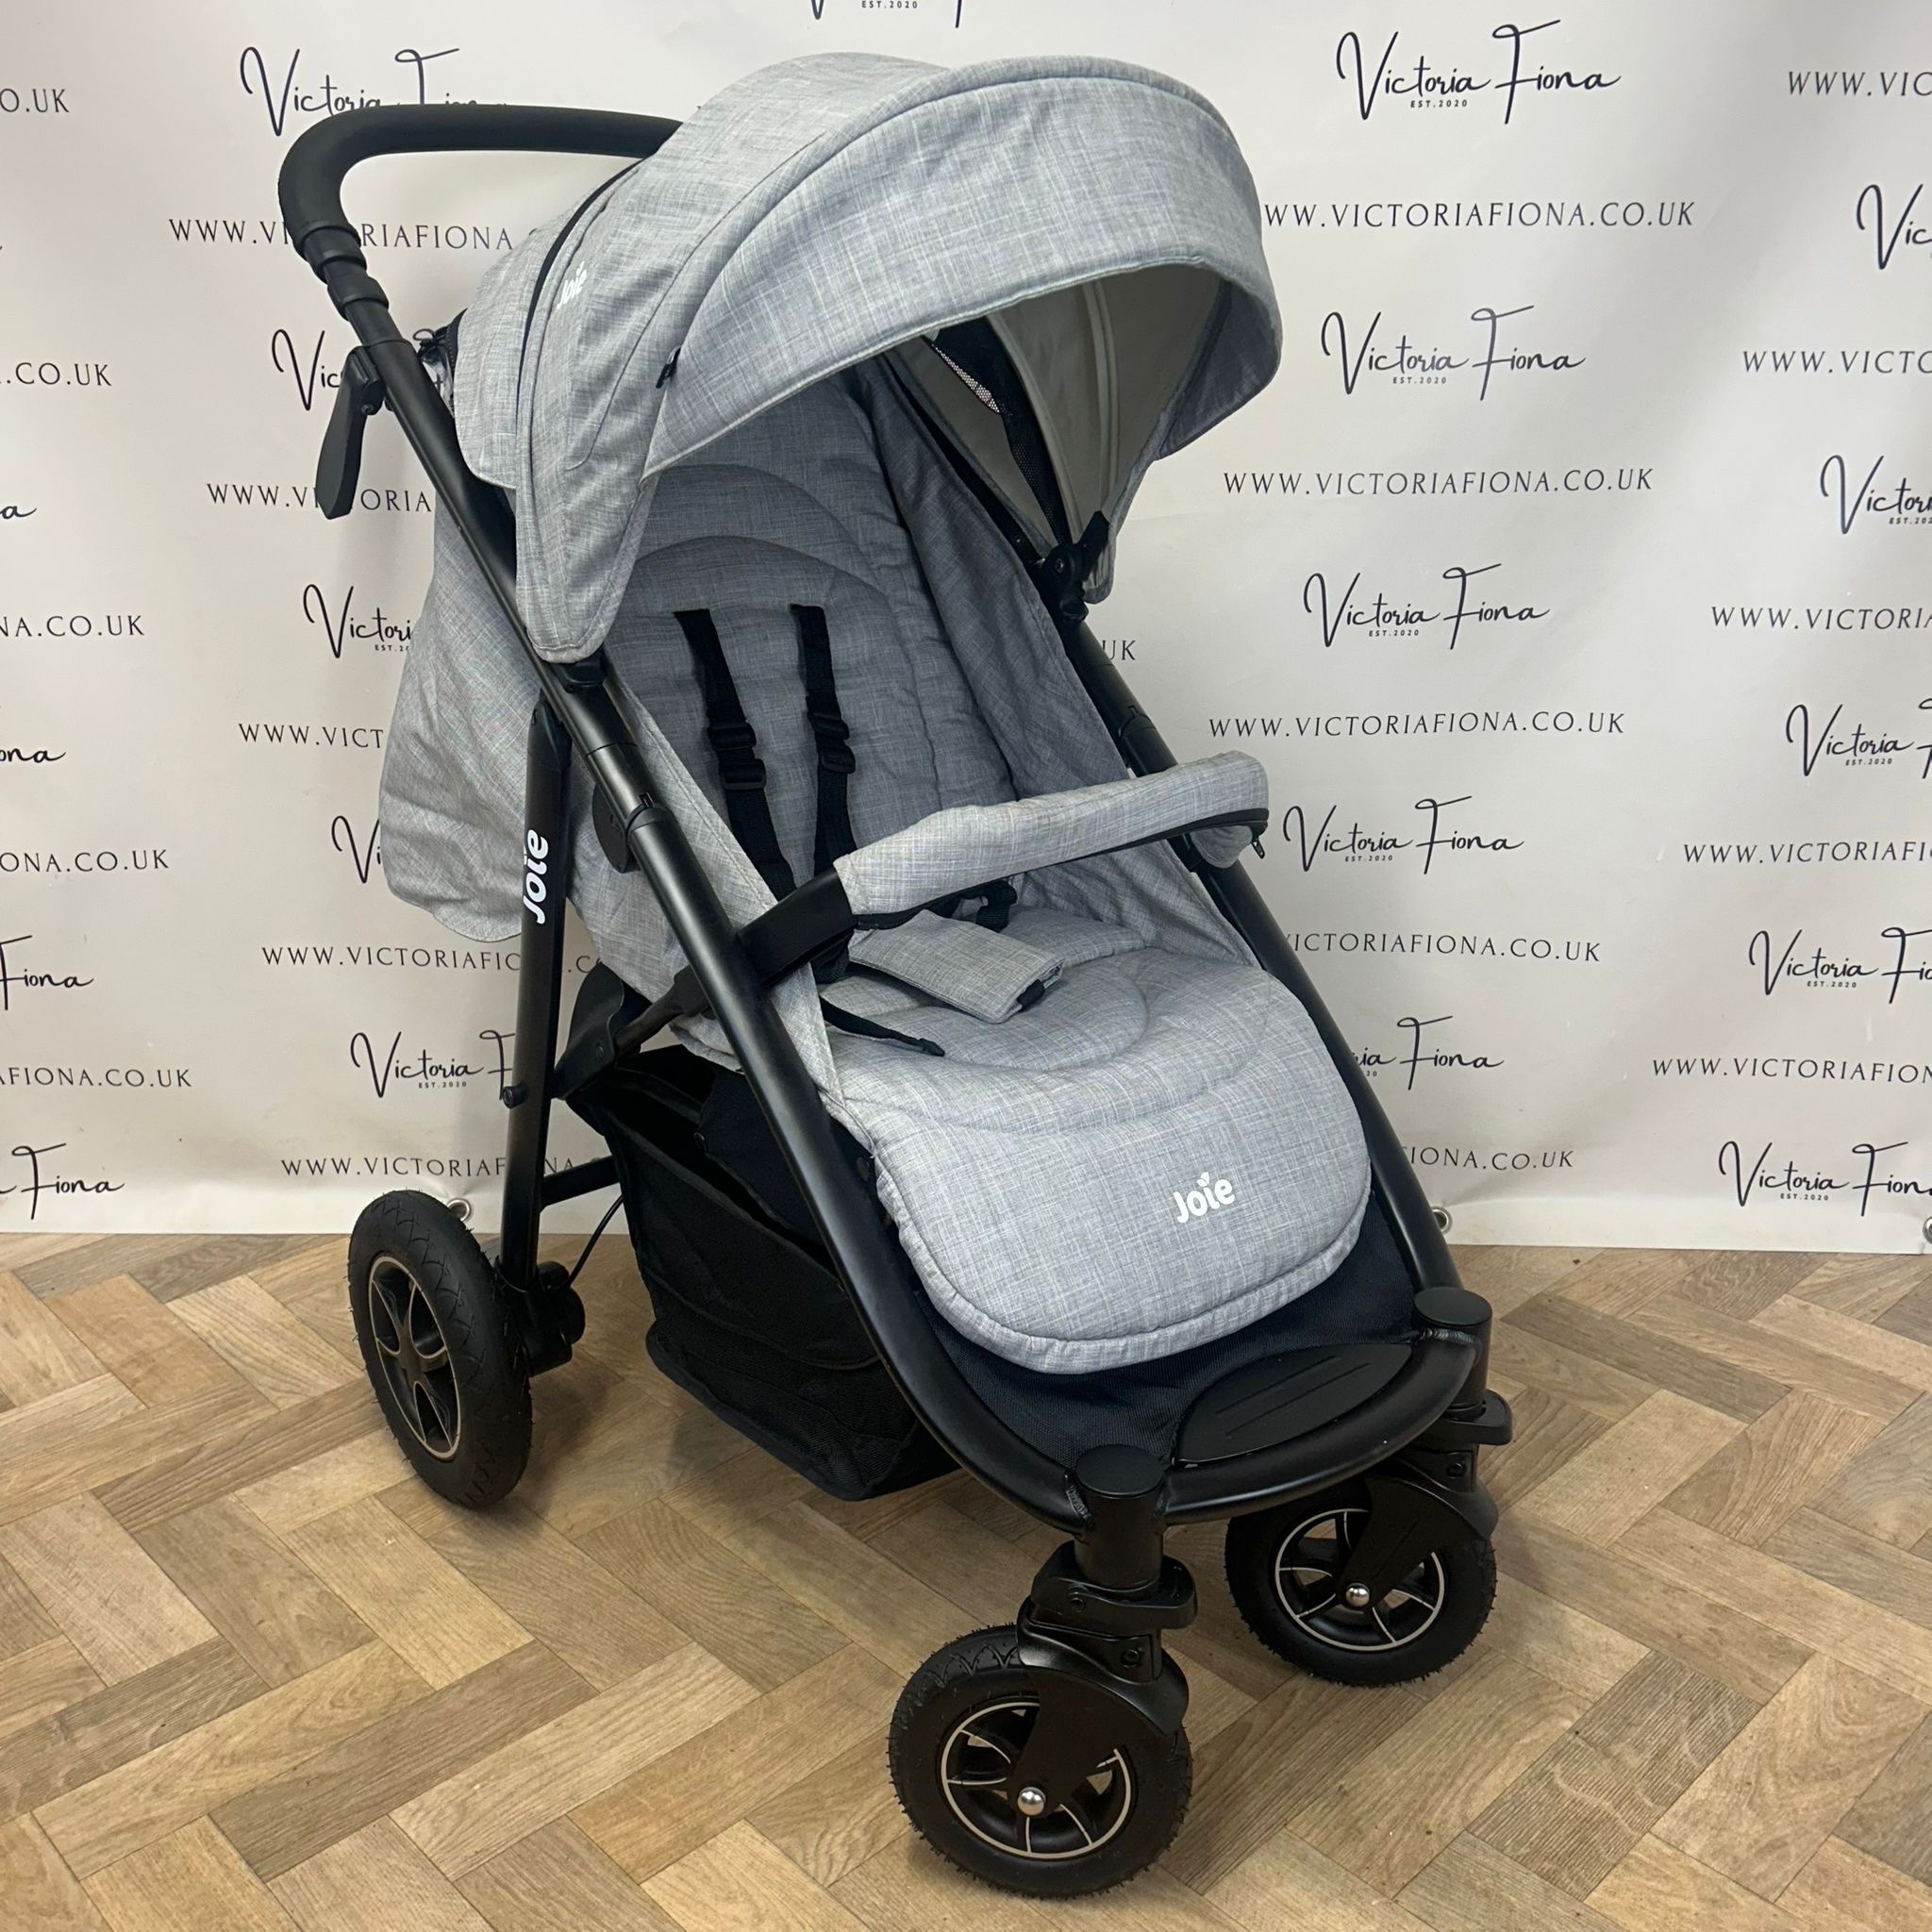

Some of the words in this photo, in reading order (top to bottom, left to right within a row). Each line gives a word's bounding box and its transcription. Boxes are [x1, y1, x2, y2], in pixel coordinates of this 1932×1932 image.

[1336, 30, 1491, 121] Victoria
[1491, 20, 1622, 125] Fiona
[1409, 99, 1468, 108] EST.2020
[1264, 202, 1695, 227] WW.VICTORIAFIONA.CO.UK
[1321, 311, 1470, 395] Victoria
[1471, 305, 1587, 401] Fiona
[1392, 376, 1447, 385] EST.2020
[1224, 468, 1654, 495] WWW.VICTORIAFIONA.CO.UK
[1303, 573, 1441, 647] Victoria
[1442, 563, 1551, 650] Fiona
[1368, 628, 1420, 637] EST.2020
[1208, 710, 1625, 739] WWW.VICTORIAFIONA.CO.UK
[1786, 704, 1915, 776] Victoria
[1283, 805, 1415, 873] Victoria
[1415, 795, 1524, 874] Fiona
[1683, 841, 1932, 864] WWW.VICTORIAFI
[1749, 929, 1879, 996] Victoria
[1807, 980, 1857, 989] EST.2020
[350, 1031, 485, 1098] Victoria
[1396, 1015, 1505, 1091] Fiona
[11, 1142, 125, 1220] Fiona
[1173, 1172, 1236, 1224] Joie
[1719, 1141, 1850, 1207] Victoria
[1852, 1141, 1932, 1217] Fion
[1779, 1193, 1829, 1202] EST.2020
